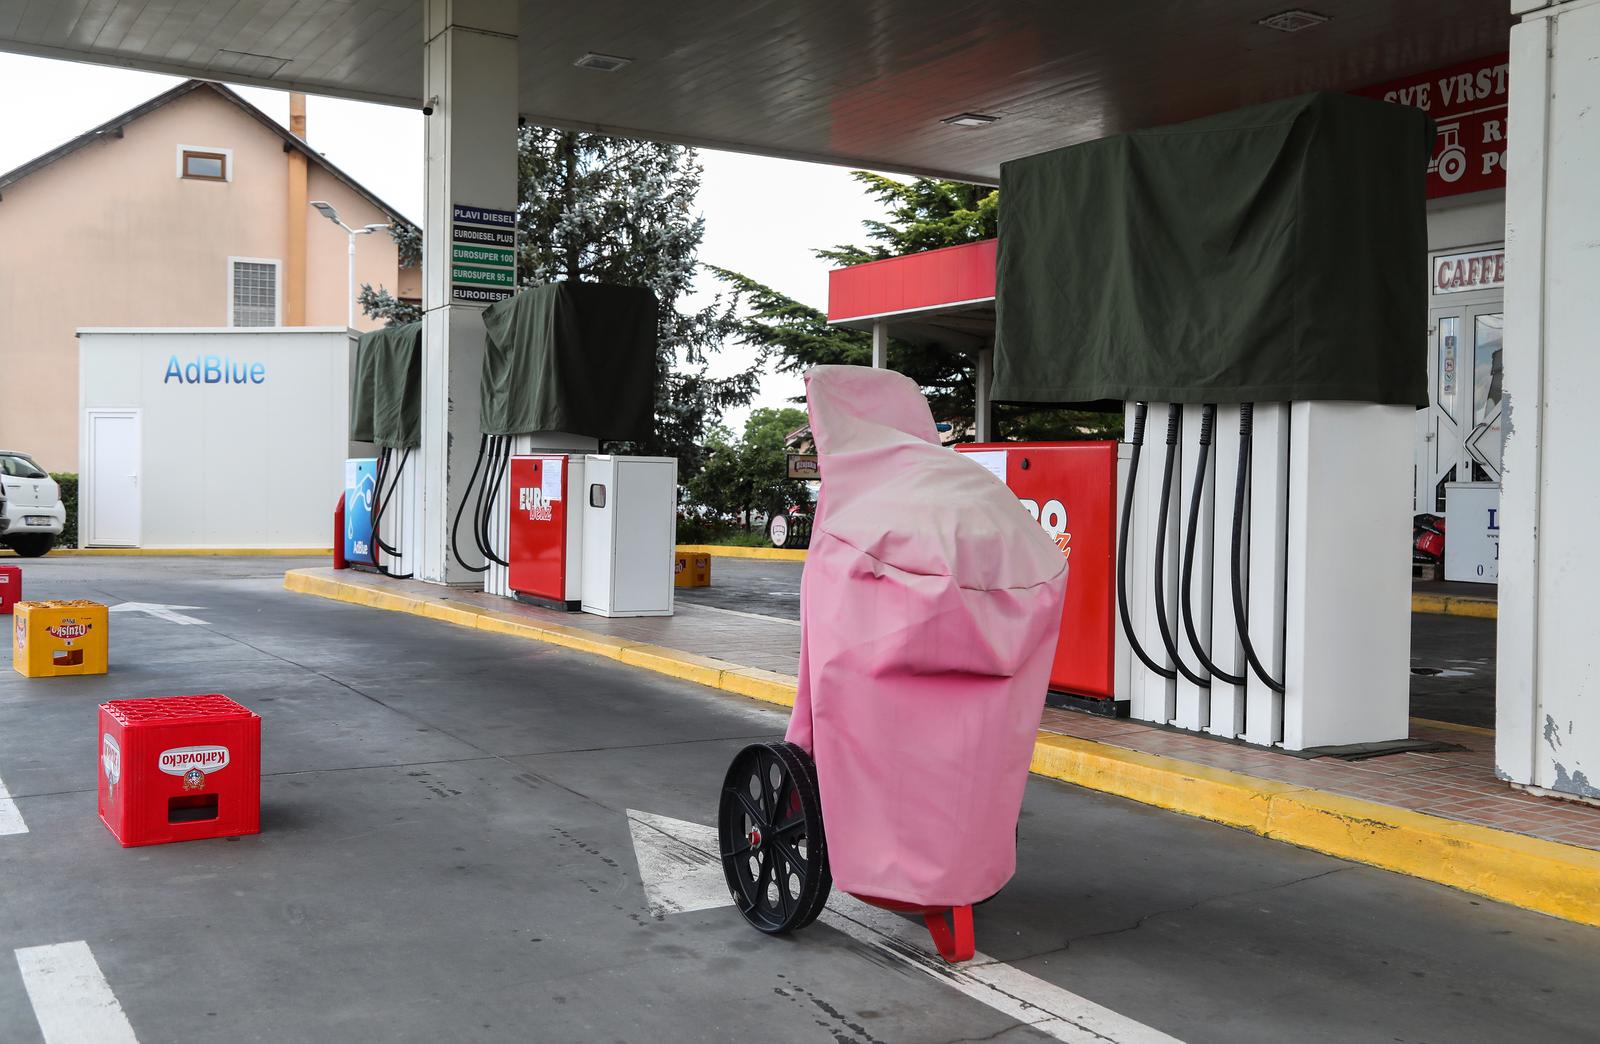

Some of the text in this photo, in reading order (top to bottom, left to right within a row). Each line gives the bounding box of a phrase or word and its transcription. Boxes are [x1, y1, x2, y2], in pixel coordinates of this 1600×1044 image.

[454, 209, 514, 224] PLAVI DIESEL
[454, 229, 513, 243] EURODIESEL PLUS
[453, 249, 513, 263] EUROSUPER 100
[453, 269, 495, 280] EUROSUPER
[497, 273, 505, 282] 95
[164, 354, 265, 384] AdBlue
